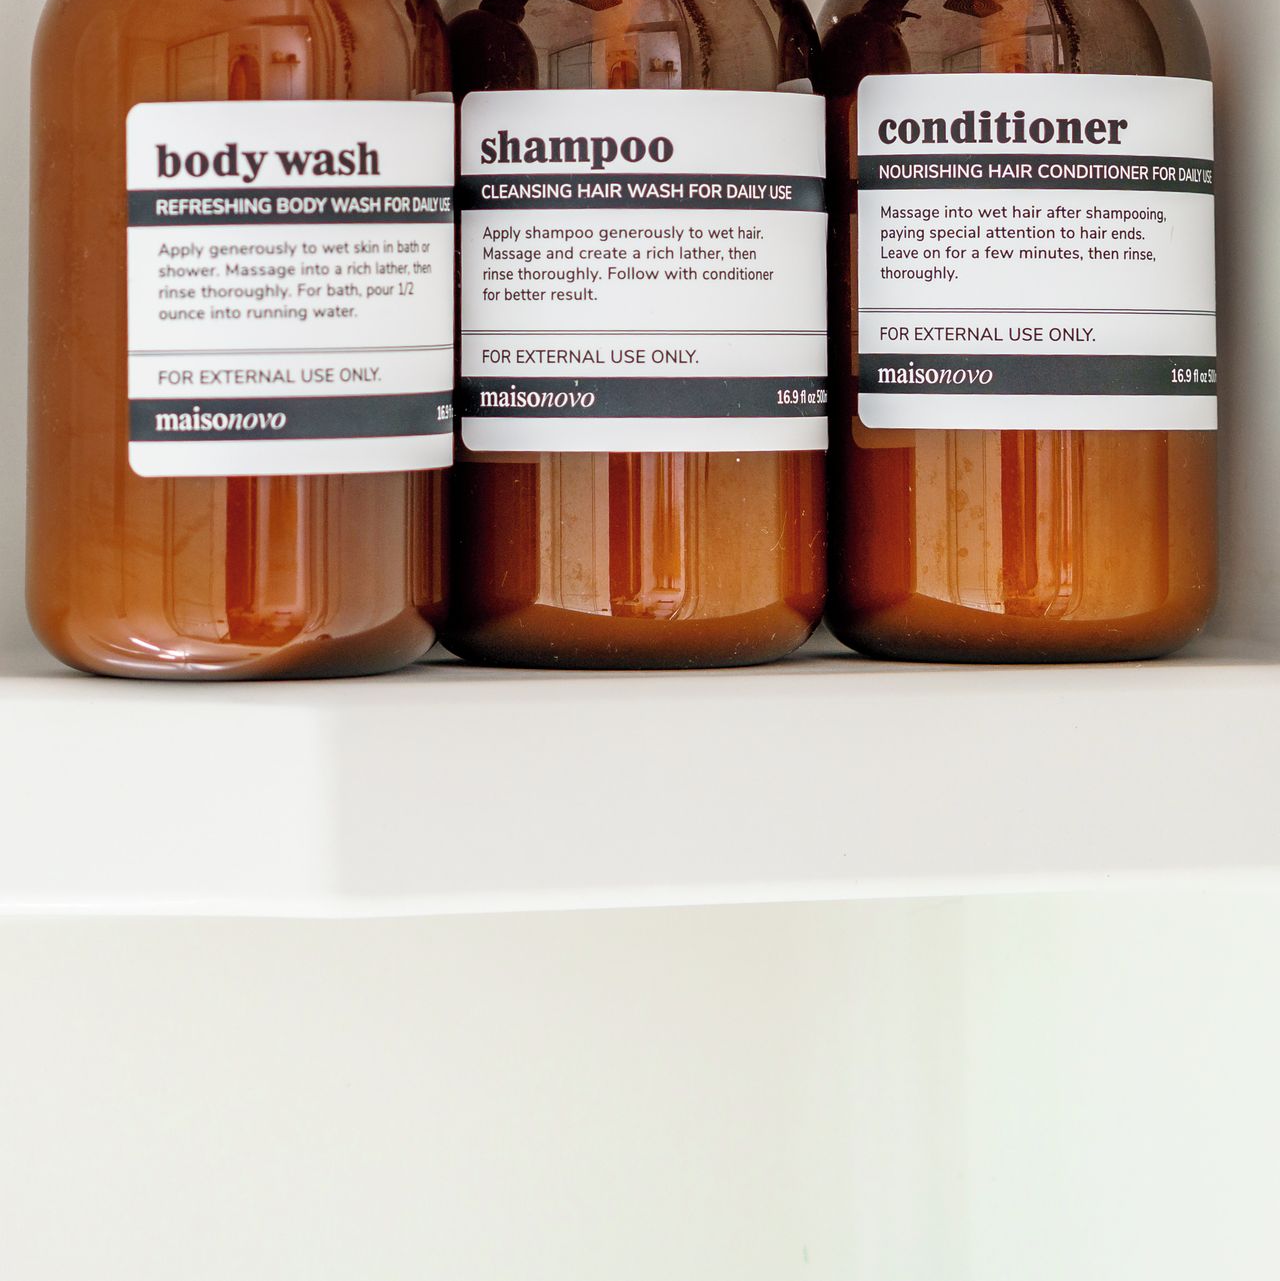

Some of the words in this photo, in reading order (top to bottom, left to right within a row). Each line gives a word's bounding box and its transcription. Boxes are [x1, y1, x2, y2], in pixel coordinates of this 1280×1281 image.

[878, 111, 1128, 144] conditioner
[481, 130, 673, 170] shampoo
[156, 143, 268, 183] body
[275, 142, 380, 176] wash
[880, 164, 982, 179] NOURISHING
[989, 164, 1032, 178] HAIR
[1038, 164, 1148, 180] CONDITIONER
[1153, 167, 1176, 181] FOR
[1179, 168, 1202, 182] DAILY
[1203, 170, 1212, 183] USE
[482, 184, 572, 199] CLEANSING
[578, 183, 622, 198] HAIR
[627, 184, 683, 198] WASH
[689, 184, 722, 198] FOR
[727, 184, 767, 199] DAILY
[770, 185, 792, 199] USE
[156, 198, 272, 215] REFRESHING
[277, 197, 327, 214] BODY
[331, 197, 381, 213] WASH
[384, 197, 410, 212] FOR
[413, 197, 440, 212] DAILY
[440, 197, 450, 211] USE
[881, 206, 939, 221] Massage
[945, 206, 973, 218] into
[978, 207, 1007, 218] wet
[1013, 206, 1041, 218] hair
[1047, 206, 1081, 218] after
[1086, 206, 1166, 223] shampooing,
[483, 226, 520, 242] Apply
[525, 226, 593, 241] shampoo
[599, 226, 684, 241] generously
[689, 227, 703, 239] to
[708, 228, 734, 239] wet
[738, 226, 763, 239] hair.
[881, 226, 924, 241] paying
[930, 226, 980, 241] special
[986, 226, 1055, 238] attention
[1060, 227, 1075, 238] to
[1081, 226, 1107, 239] hair
[1112, 227, 1144, 240] ends.
[158, 243, 203, 259] Apply
[209, 242, 297, 259] generously
[302, 243, 317, 254] to
[322, 243, 349, 254] wet
[354, 240, 379, 254] skin
[383, 240, 393, 253] in
[397, 240, 419, 253] bath
[421, 243, 430, 253] or
[484, 247, 541, 262] Massage
[547, 247, 573, 259] and
[579, 248, 627, 259] create
[633, 250, 640, 259] a
[647, 246, 673, 259] rich
[680, 247, 724, 261] lather,
[728, 247, 756, 259] then
[881, 246, 918, 259] Leave
[923, 250, 940, 258] on
[945, 246, 967, 258] for
[972, 250, 979, 258] a
[985, 246, 1014, 258] few
[1020, 246, 1083, 261] minutes,
[1088, 247, 1119, 259] then
[1124, 247, 1155, 262] rinse,
[159, 265, 219, 278] shower.
[226, 264, 295, 279] Massage
[301, 263, 330, 275] into
[335, 265, 342, 275] a
[347, 262, 371, 275] rich
[376, 262, 410, 275] lather,
[413, 261, 431, 274] then
[483, 268, 513, 280] rinse
[518, 267, 601, 283] thoroughly.
[608, 267, 659, 279] Follow
[665, 267, 697, 280] with
[703, 267, 773, 280] conditioner
[880, 266, 958, 282] thoroughly.
[159, 286, 196, 299] rinse
[201, 284, 291, 301] thoroughly.
[297, 283, 321, 297] For
[327, 283, 362, 297] bath,
[366, 286, 394, 298] pour
[399, 282, 414, 296] 1/2
[483, 288, 500, 300] for
[505, 288, 546, 300] better
[551, 288, 597, 300] result.
[159, 309, 205, 320] ounce
[211, 307, 241, 319] into
[247, 305, 307, 321] running
[313, 306, 357, 317] water.
[881, 327, 909, 340] FOR
[915, 327, 1003, 341] EXTERNAL
[1009, 328, 1043, 341] USE
[1049, 328, 1095, 341] ONLY.
[483, 350, 510, 363] FOR
[517, 350, 605, 363] EXTERNAL
[611, 350, 645, 363] USE
[652, 350, 698, 363] ONLY.
[159, 370, 193, 385] FOR
[200, 370, 295, 384] EXTERNAL
[301, 368, 334, 383] USE
[340, 368, 381, 382] ONLY.
[878, 361, 993, 384] maisonovo
[1172, 369, 1191, 382] 16.9
[1193, 369, 1198, 382] fl
[1200, 373, 1207, 382] oz
[480, 383, 595, 408] maisonovo
[777, 390, 798, 404] 16.9
[800, 390, 806, 403] fl
[808, 394, 816, 403] oz
[155, 406, 286, 431] maisonovo
